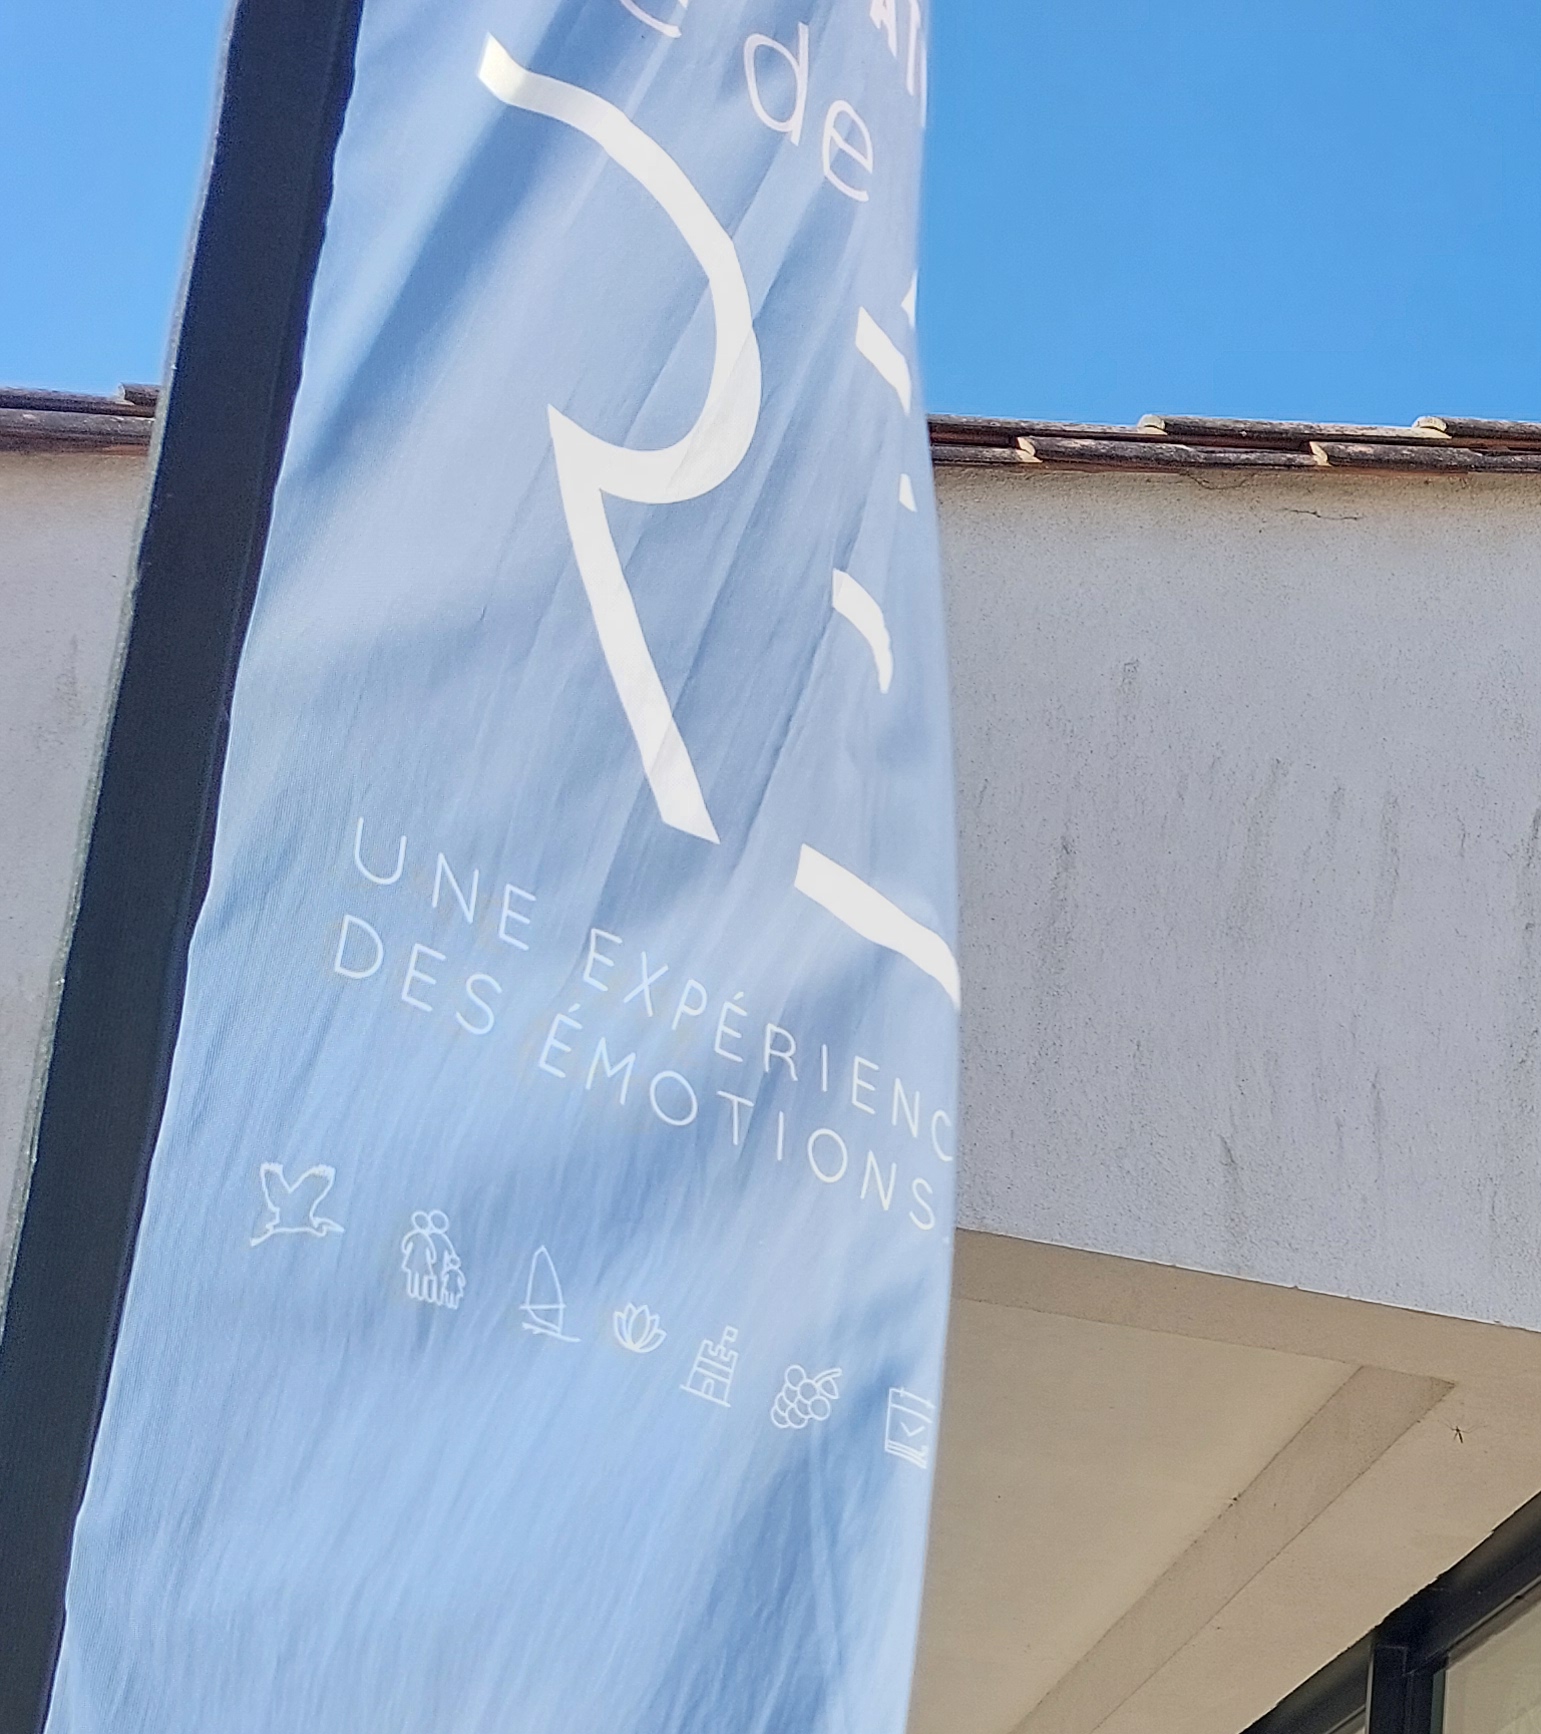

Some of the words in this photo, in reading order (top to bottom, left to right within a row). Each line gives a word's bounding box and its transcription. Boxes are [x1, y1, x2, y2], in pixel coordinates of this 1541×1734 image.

[743, 21, 873, 202] de
[353, 816, 537, 951] UNE
[333, 914, 502, 1036] DES
[537, 1002, 937, 1231] ÉMOTIONS
